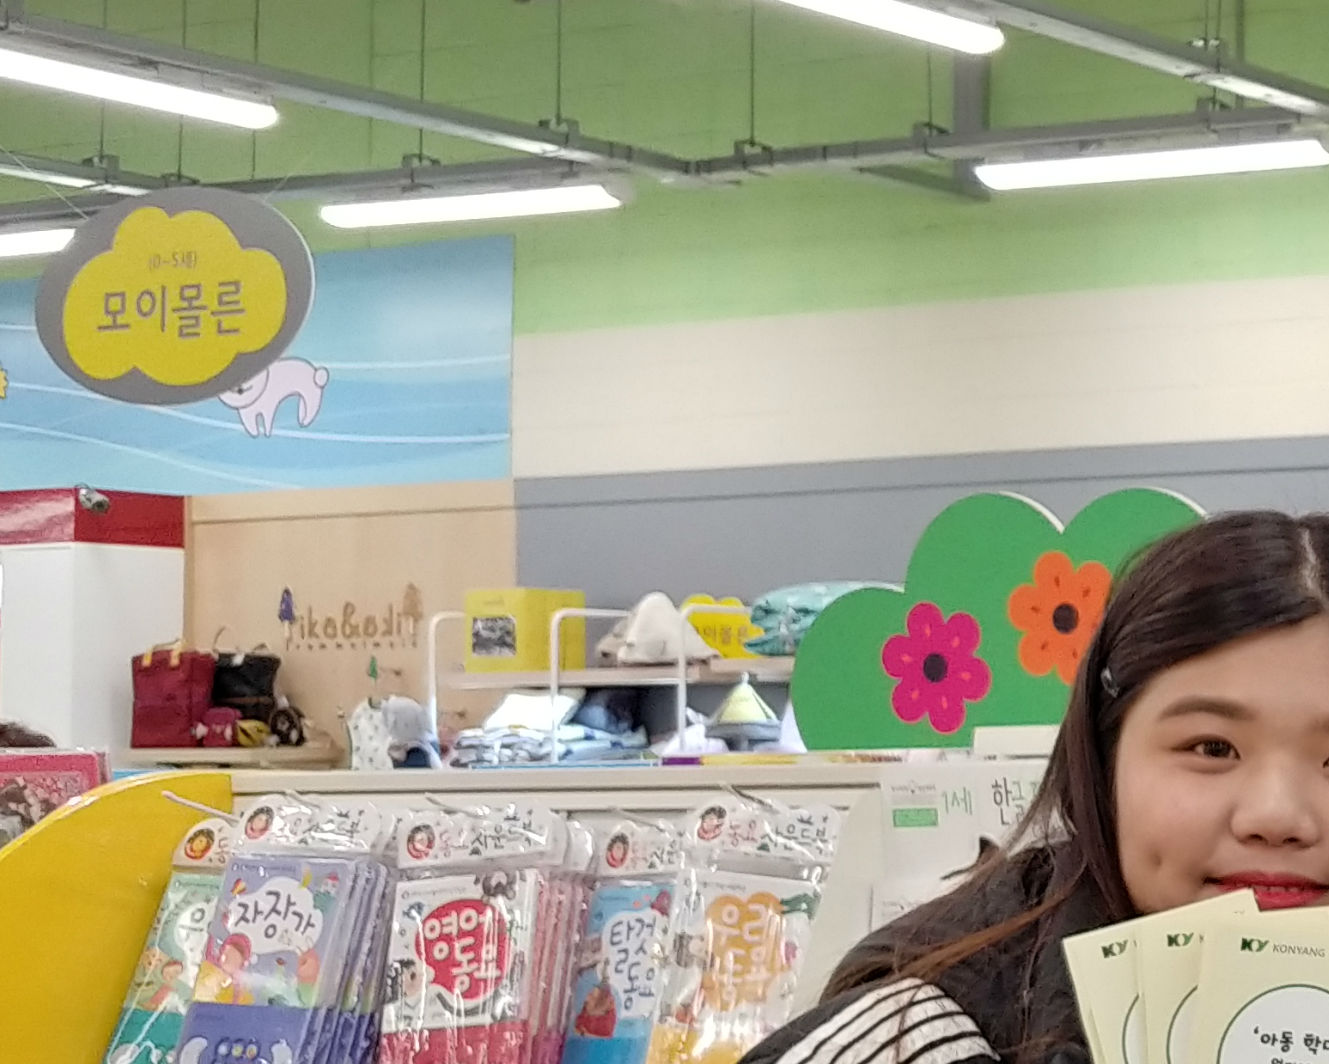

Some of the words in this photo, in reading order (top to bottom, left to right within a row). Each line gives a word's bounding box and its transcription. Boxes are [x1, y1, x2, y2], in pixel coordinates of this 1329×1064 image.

[97, 280, 246, 340] 모이몰른
[234, 889, 317, 940] 자장가
[1240, 937, 1270, 953] KY
[1272, 943, 1326, 959] KONYANG
